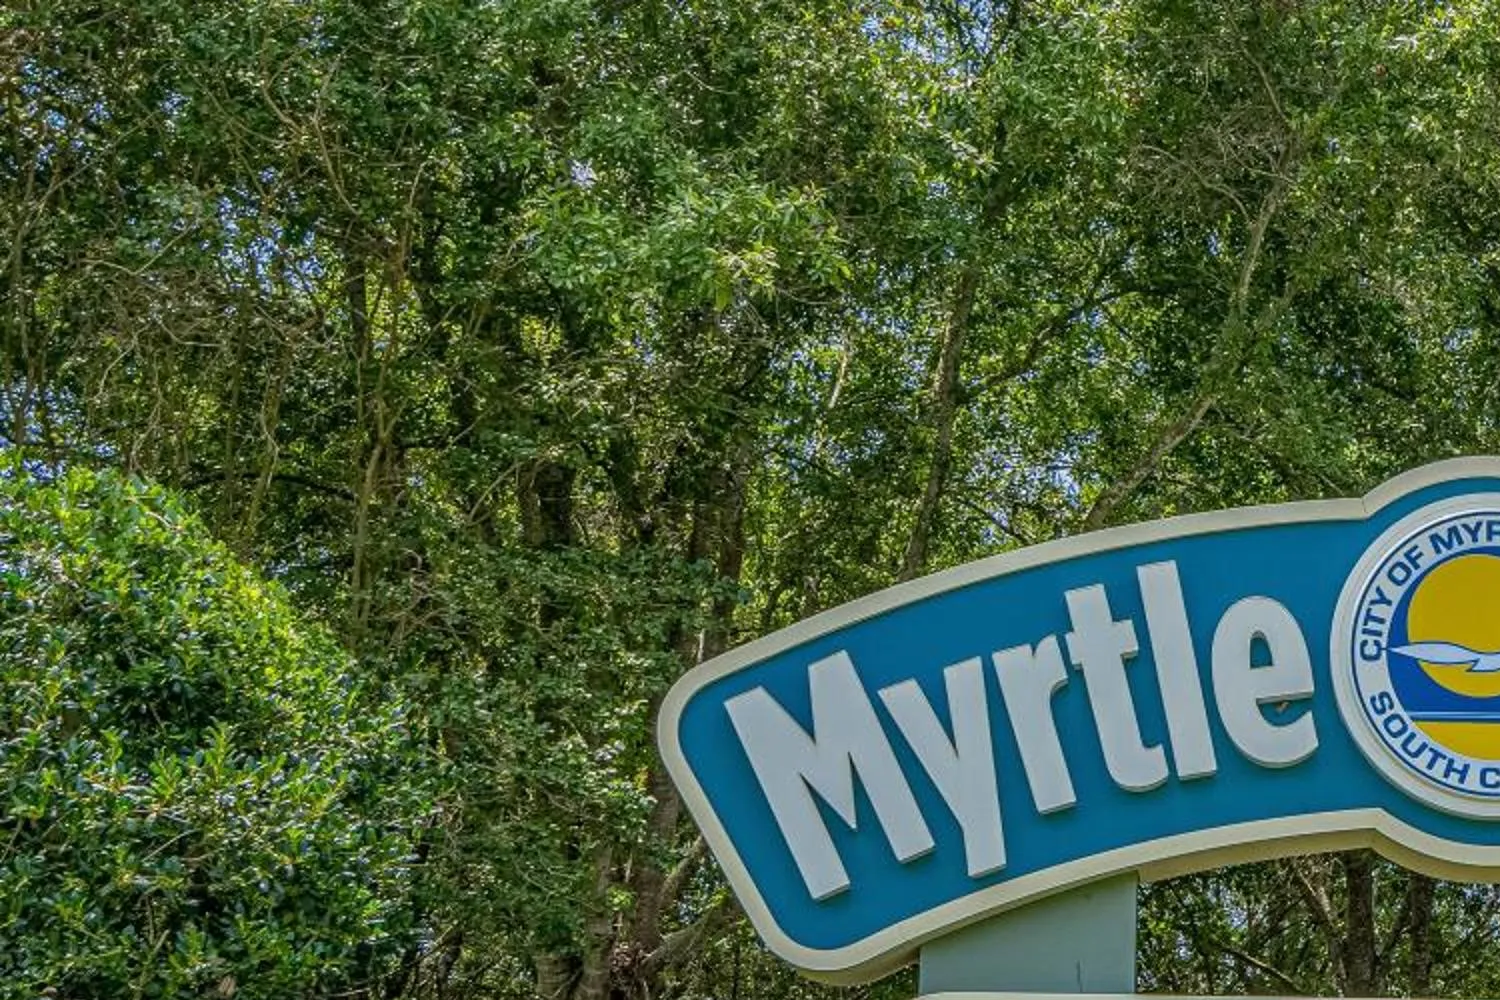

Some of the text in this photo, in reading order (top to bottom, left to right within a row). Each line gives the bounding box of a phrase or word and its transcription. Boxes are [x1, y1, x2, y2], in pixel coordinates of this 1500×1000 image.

[1359, 586, 1393, 663] CITY
[1387, 545, 1427, 588] OF
[723, 559, 1319, 901] Myrtle
[1369, 691, 1471, 785] SOUTH
